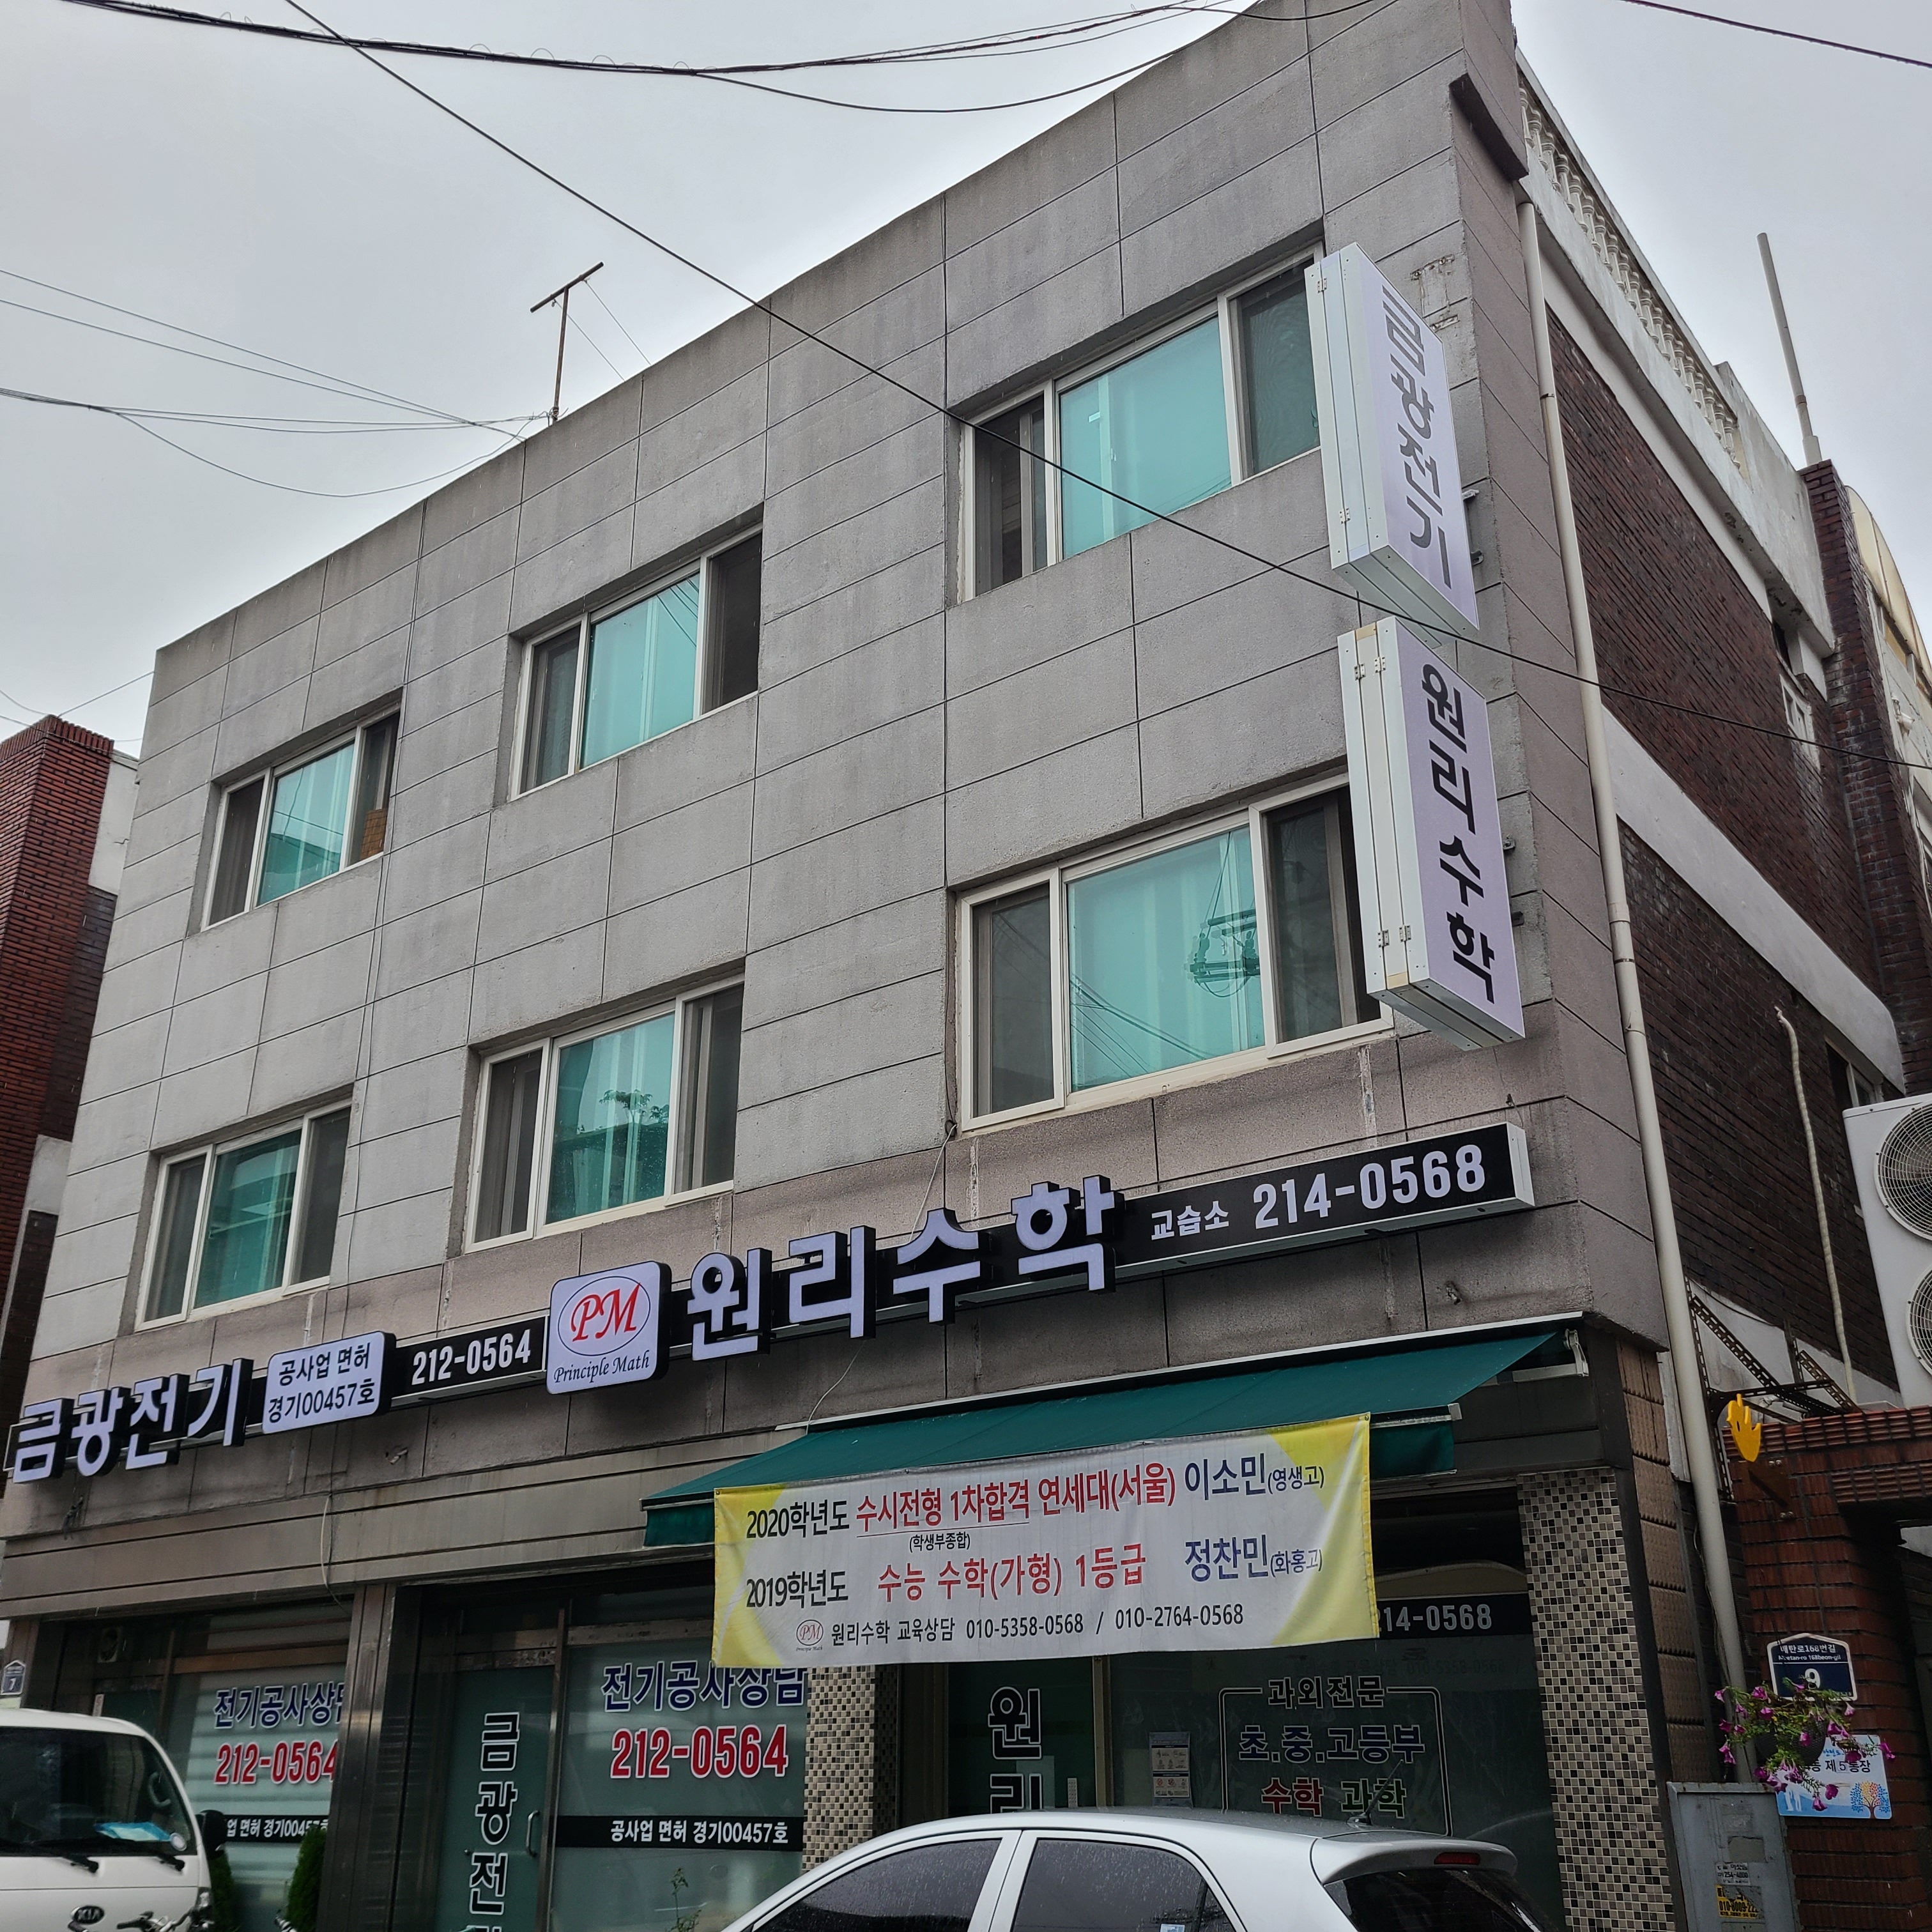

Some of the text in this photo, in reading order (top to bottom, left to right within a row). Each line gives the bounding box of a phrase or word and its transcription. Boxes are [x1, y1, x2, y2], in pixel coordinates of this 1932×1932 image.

[1382, 284, 1453, 590] 금광전기
[1421, 663, 1495, 1005] 원리수학
[687, 1144, 1486, 1361] 원리수학 교습소 214-0568
[571, 1282, 641, 1342] PM
[278, 1342, 371, 1387] 공사업 면허
[411, 1330, 532, 1386] 212-0564
[553, 1349, 650, 1384] Principle Math
[12, 1358, 242, 1483] 금광전기
[268, 1377, 376, 1423] 경기00457호
[746, 1452, 1325, 1539] 2020학년도 수시전형 1차합격 연세대(서울) 이소민(영생고)
[909, 1532, 971, 1553] (학생부종합)
[746, 1535, 1323, 1609] 2019학년도 수능 수학(가형) 1등급 정찬민(화홍고)
[831, 1620, 891, 1646] 원리수학
[897, 1617, 955, 1642] 교육상담
[966, 1614, 1084, 1639] 010-5358-0568
[1115, 1604, 1244, 1630] 010-2764-0568
[601, 1661, 807, 1712] 전기공사상담
[1268, 1675, 1384, 1710] 과외전문
[1804, 1668, 1821, 1689] 9
[214, 1739, 339, 1785] 212-0564
[610, 1724, 788, 1779] 212-0564
[1239, 1724, 1425, 1764] 초.중.고등부
[1261, 1777, 1406, 1819] 수학 과학
[240, 1818, 261, 1838] 면허
[470, 1712, 520, 1932] 금광전
[610, 1820, 789, 1845] 공사업 면허 경기00457호
